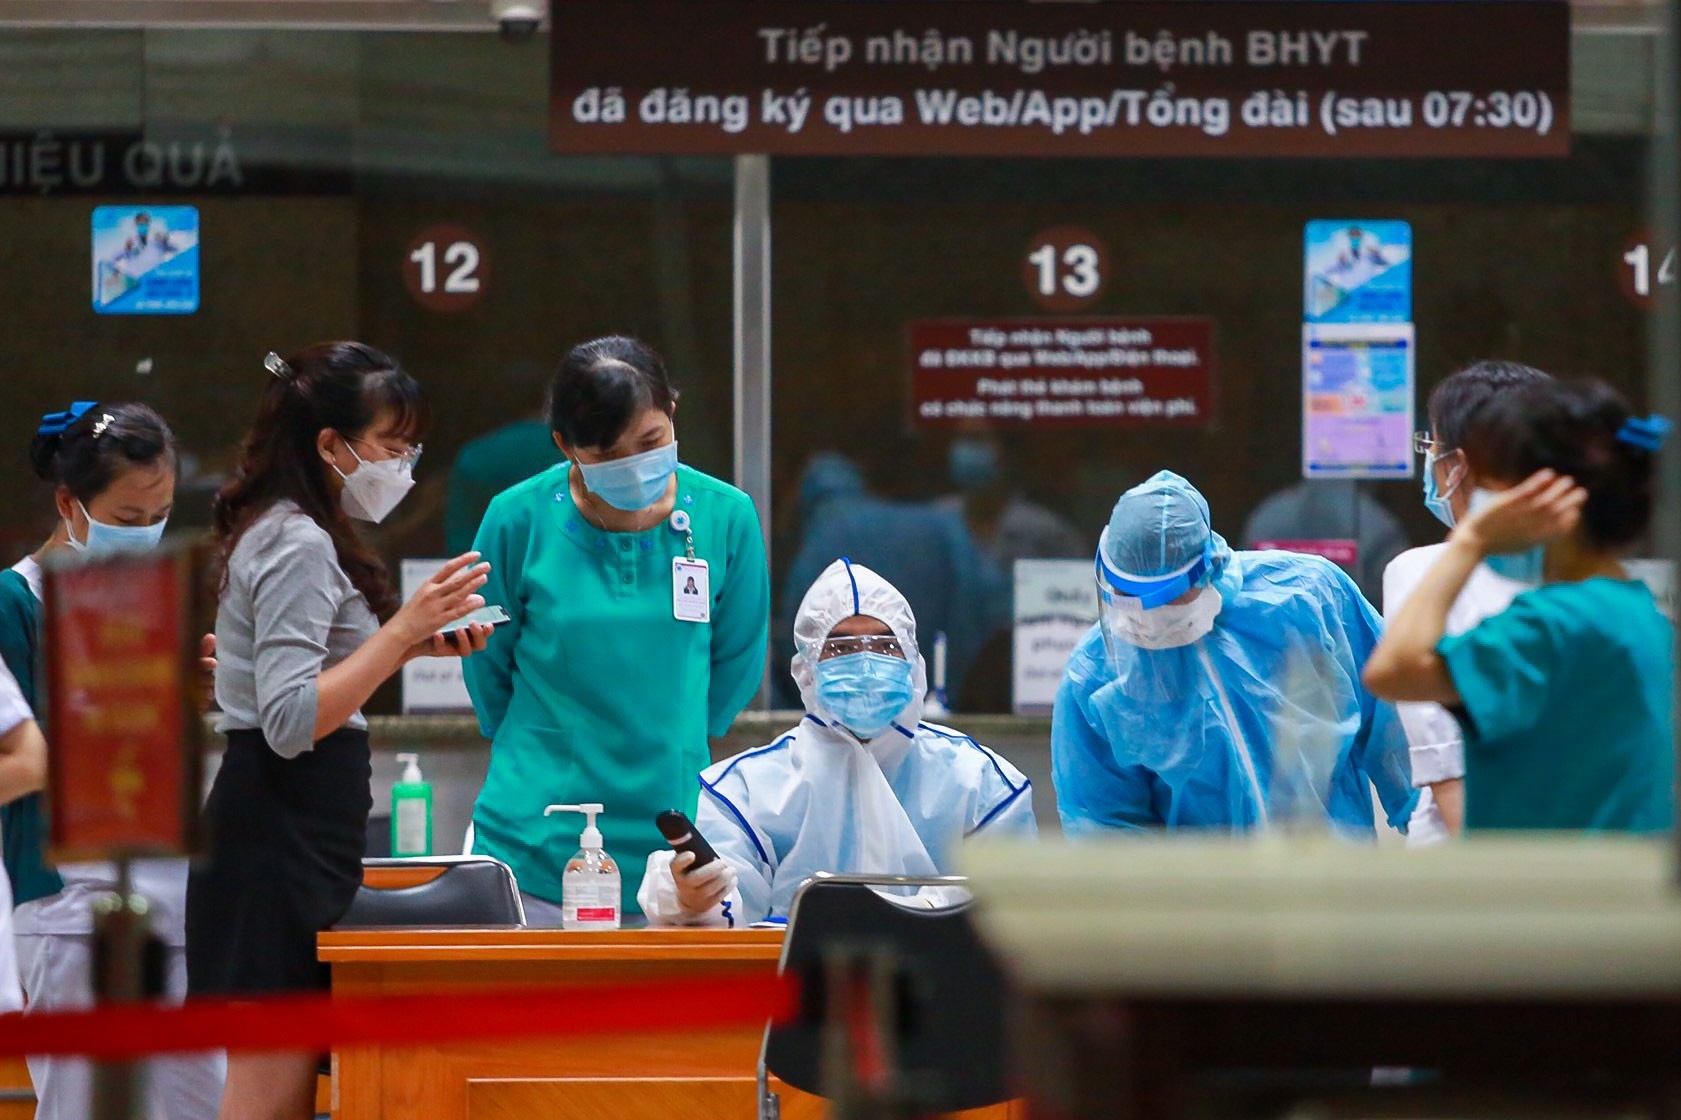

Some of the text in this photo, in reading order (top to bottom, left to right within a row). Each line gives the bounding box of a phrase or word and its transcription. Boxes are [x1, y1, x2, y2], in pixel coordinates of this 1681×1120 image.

[759, 24, 1367, 74] Tiếp nhận Người bệnh BHYT
[573, 84, 1553, 135] đã đăng ký qua Web/App/Tổng đài (sau 07:30)
[0, 131, 105, 195] IỆU
[410, 241, 480, 293] 12
[1028, 244, 1100, 297] 13
